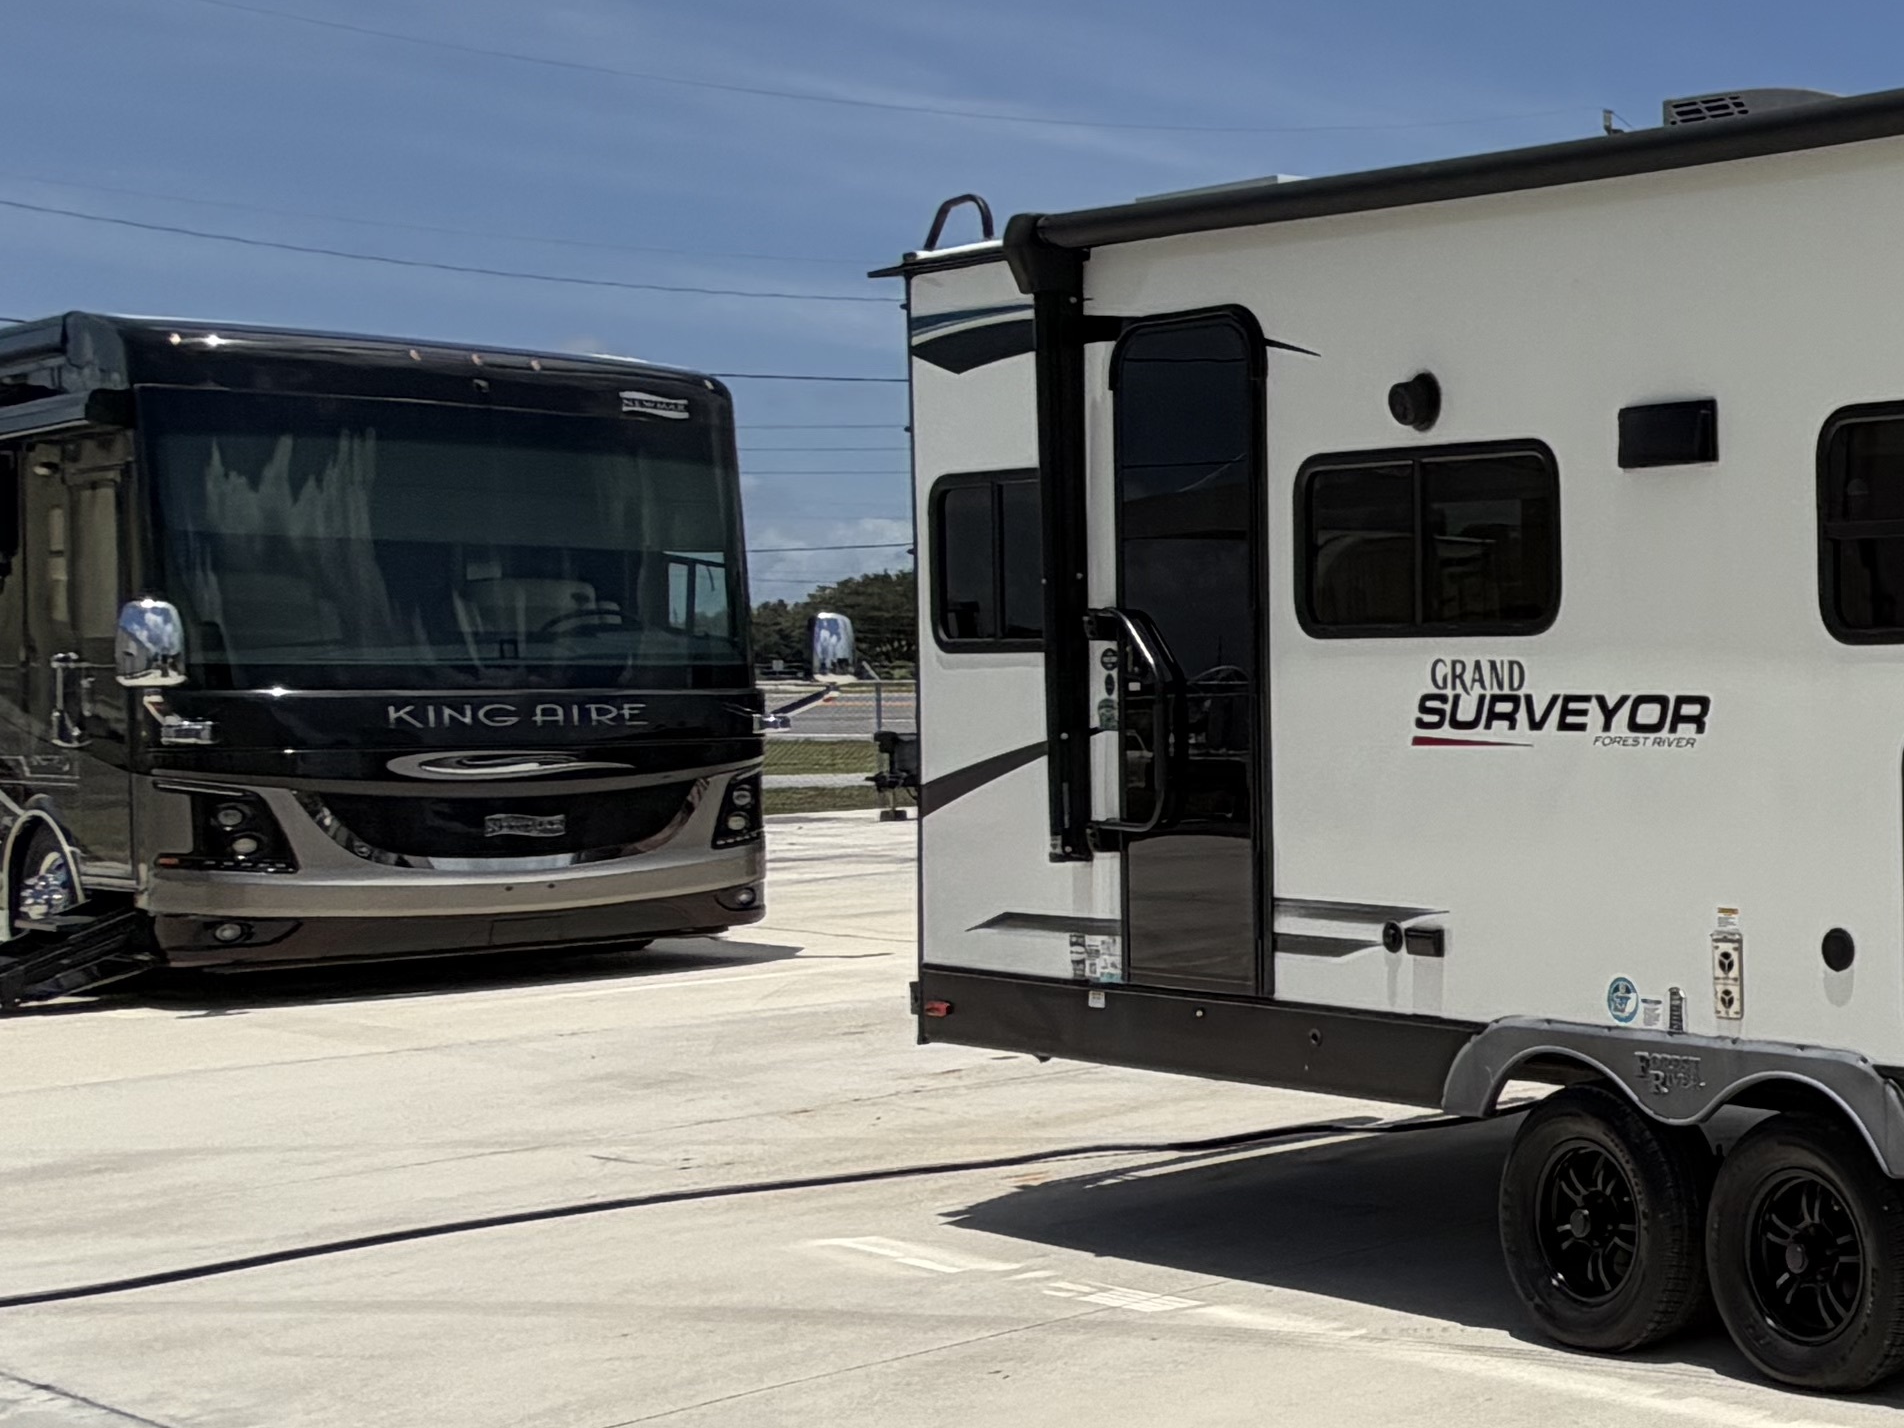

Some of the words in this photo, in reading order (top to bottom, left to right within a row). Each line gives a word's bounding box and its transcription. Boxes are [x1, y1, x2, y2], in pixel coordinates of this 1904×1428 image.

[1430, 658, 1525, 696] GRAND
[388, 704, 520, 728] KING
[532, 703, 649, 726] AIRE
[1415, 693, 1711, 734] SURVEYOR
[1593, 735, 1650, 747] FOREST
[1652, 737, 1697, 748] RIVER
